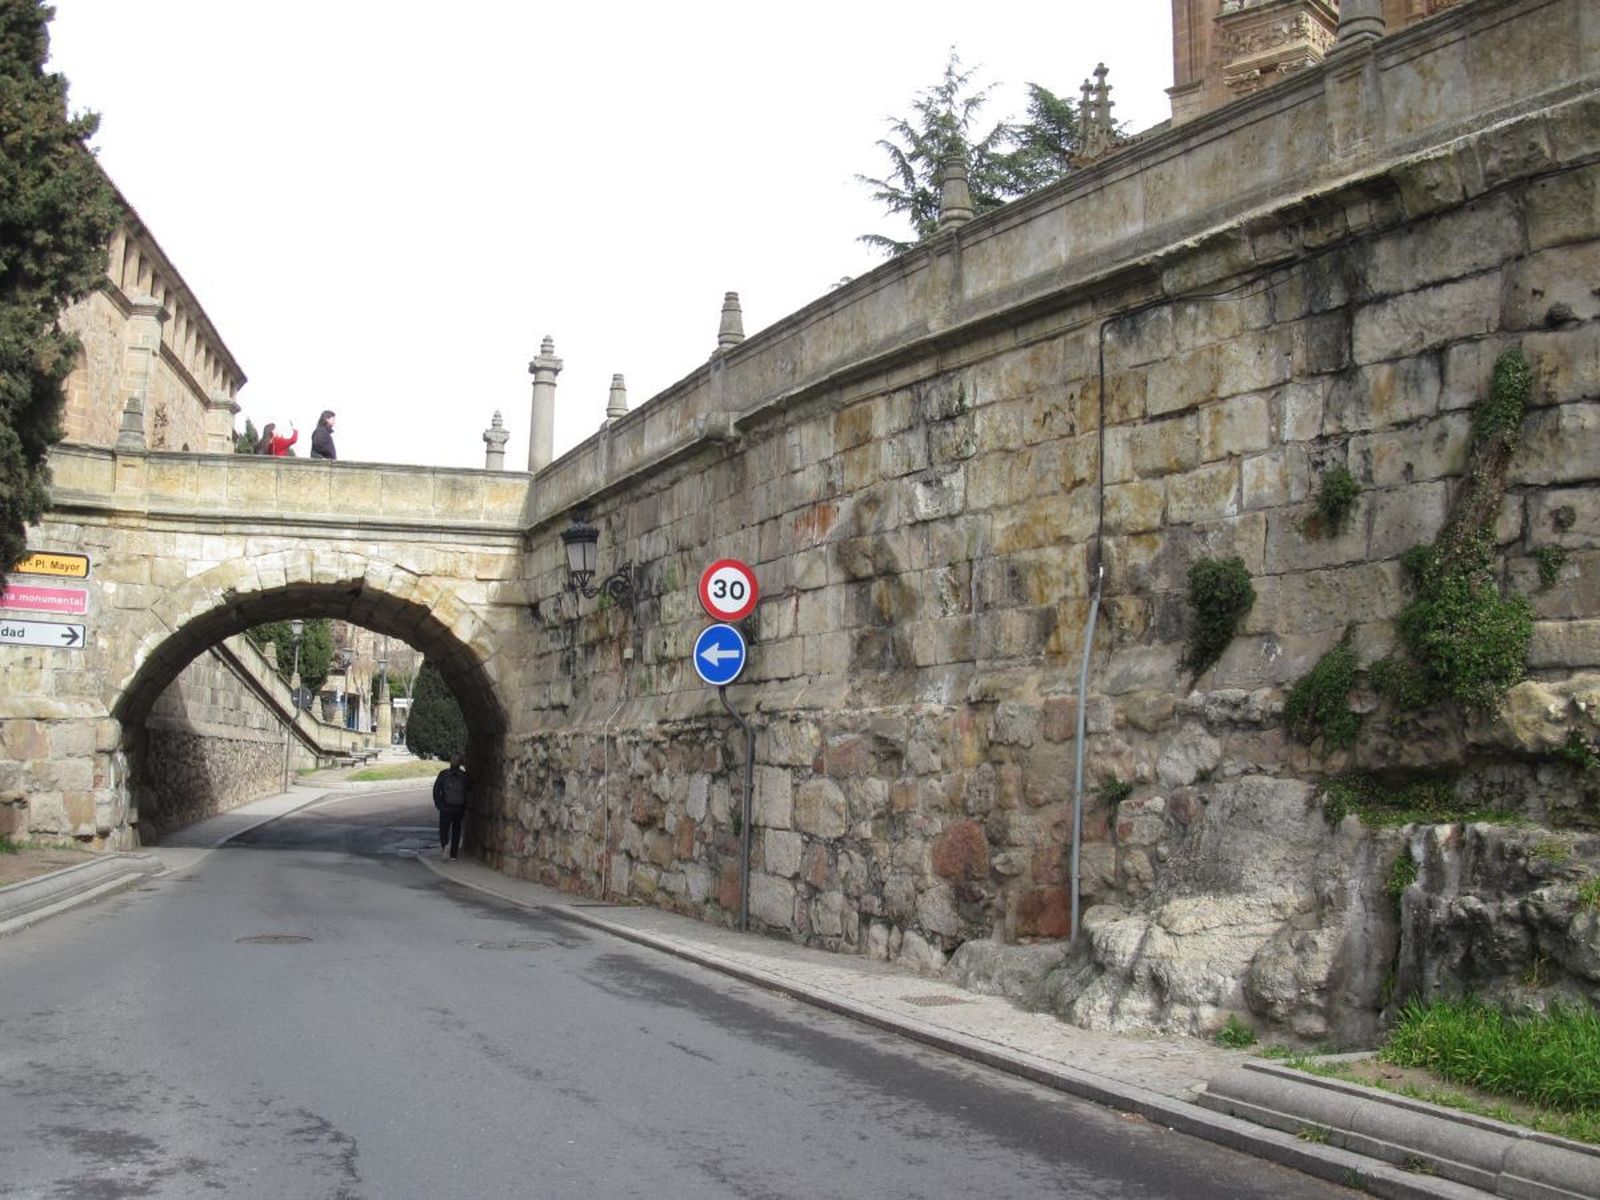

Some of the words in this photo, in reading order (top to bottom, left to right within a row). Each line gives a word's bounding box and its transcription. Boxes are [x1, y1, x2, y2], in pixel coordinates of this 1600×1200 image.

[50, 560, 80, 573] Mayor
[713, 579, 745, 600] 30
[20, 594, 84, 607] monumental
